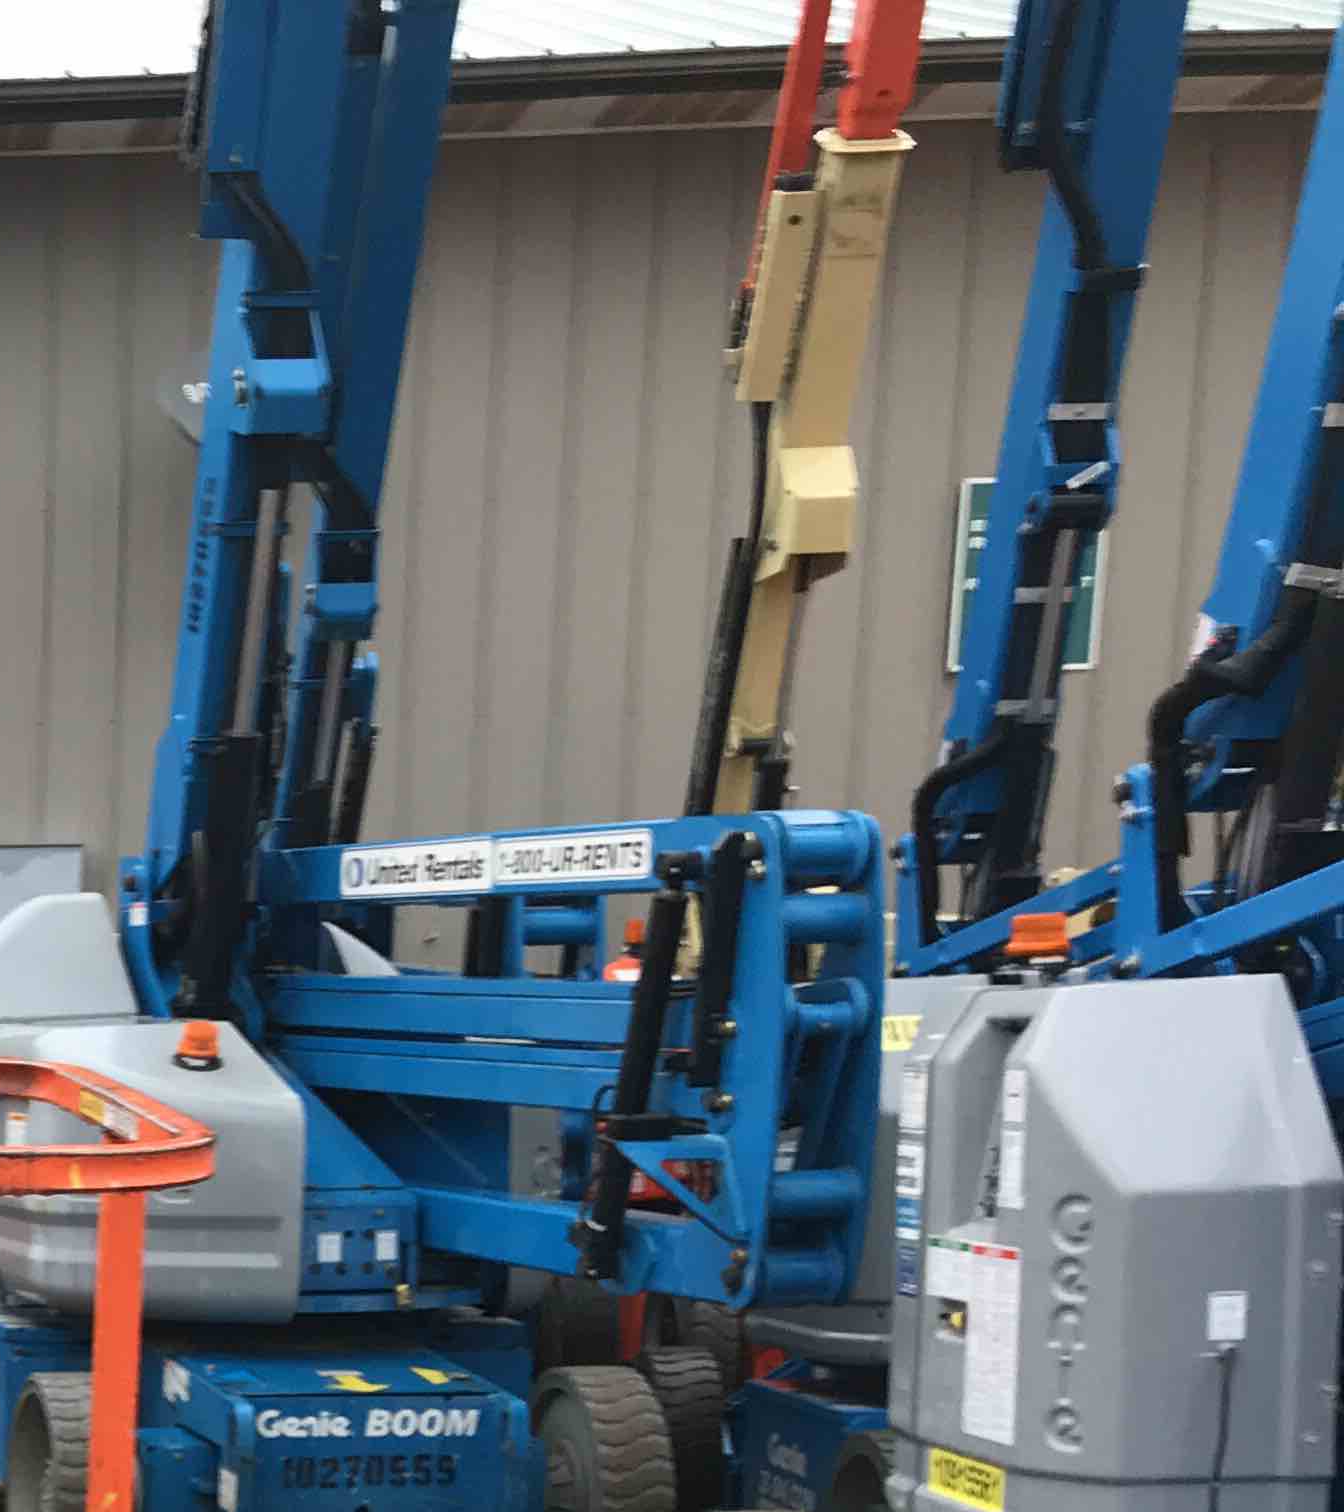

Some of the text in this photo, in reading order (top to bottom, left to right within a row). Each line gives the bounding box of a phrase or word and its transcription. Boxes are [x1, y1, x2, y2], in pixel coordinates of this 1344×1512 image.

[425, 852, 484, 882] Rentals
[256, 1408, 481, 1438] Genie BOOM
